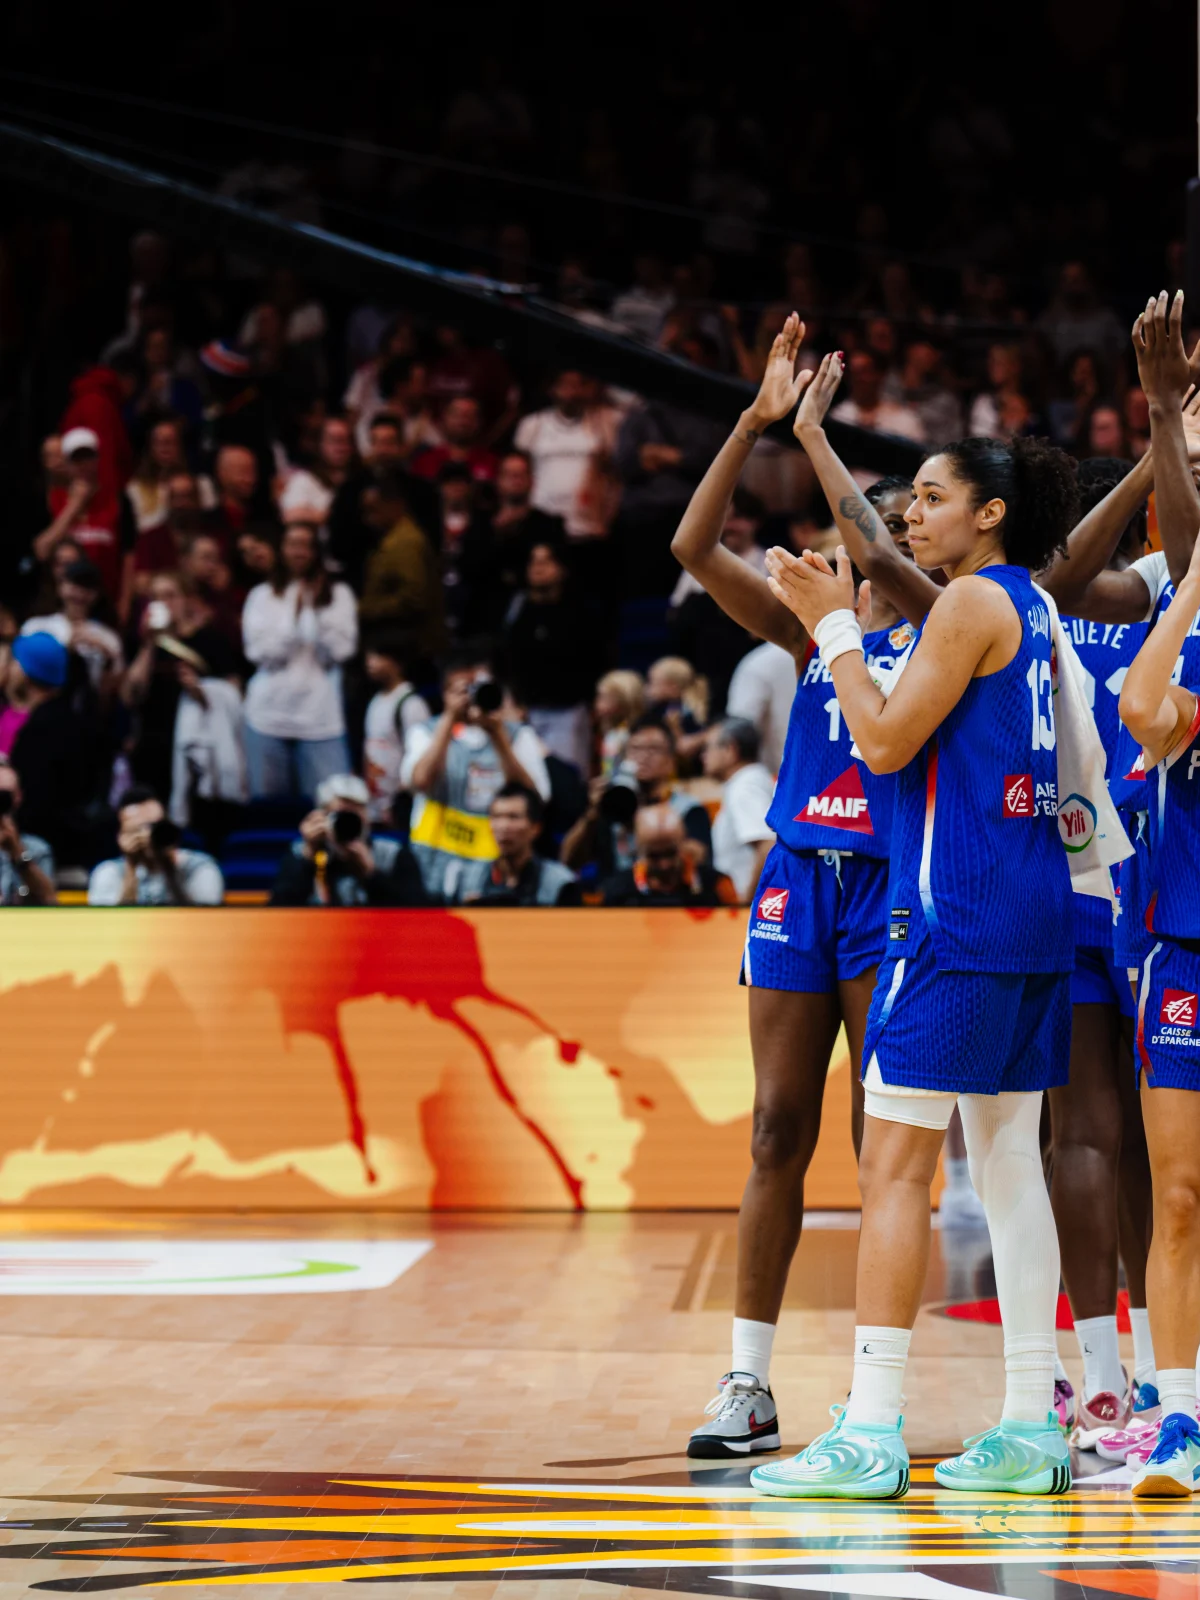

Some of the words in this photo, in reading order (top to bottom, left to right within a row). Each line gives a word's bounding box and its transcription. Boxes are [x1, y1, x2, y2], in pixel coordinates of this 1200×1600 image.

[1026, 658, 1056, 752] 13
[807, 795, 869, 818] MAIF
[1061, 809, 1086, 838] Yili
[1160, 1026, 1193, 1037] CAISSE
